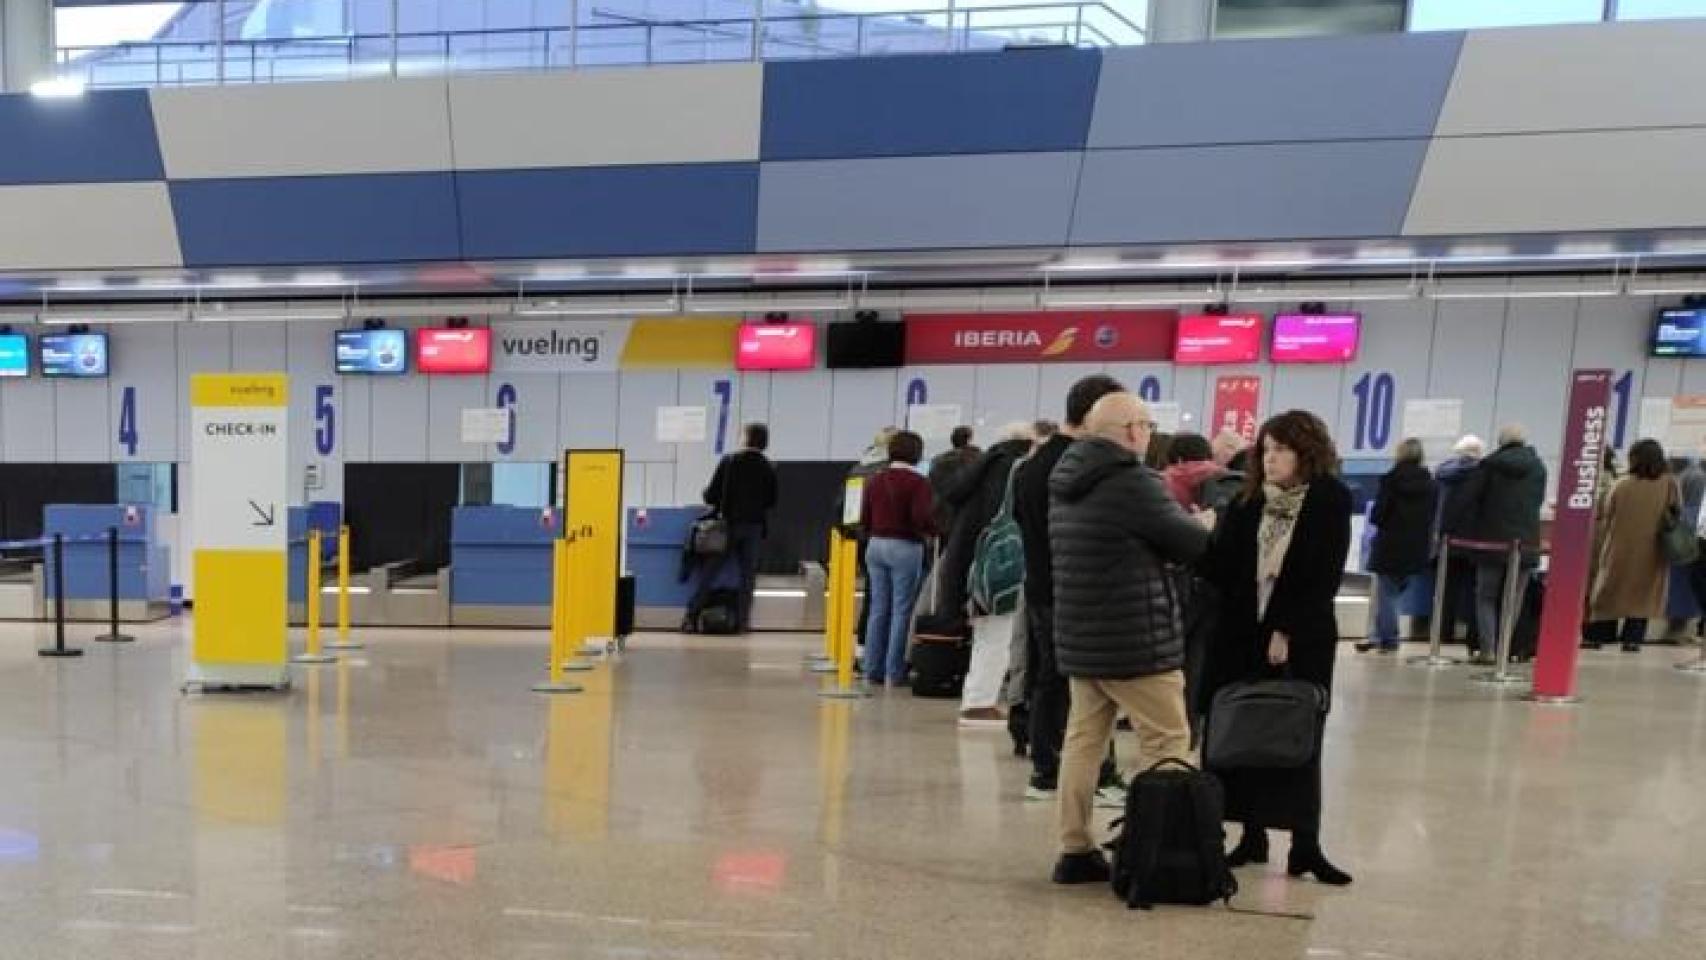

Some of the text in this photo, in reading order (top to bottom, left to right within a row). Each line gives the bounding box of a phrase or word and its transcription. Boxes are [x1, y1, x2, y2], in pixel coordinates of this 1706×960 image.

[502, 331, 600, 362] vueling
[954, 330, 1041, 347] IBERIA
[119, 386, 139, 456] 4
[205, 422, 276, 436] CHECK-IN
[316, 385, 335, 456] 5
[714, 379, 732, 454] 7
[1353, 370, 1395, 450] 10
[1568, 405, 1605, 510] Business
